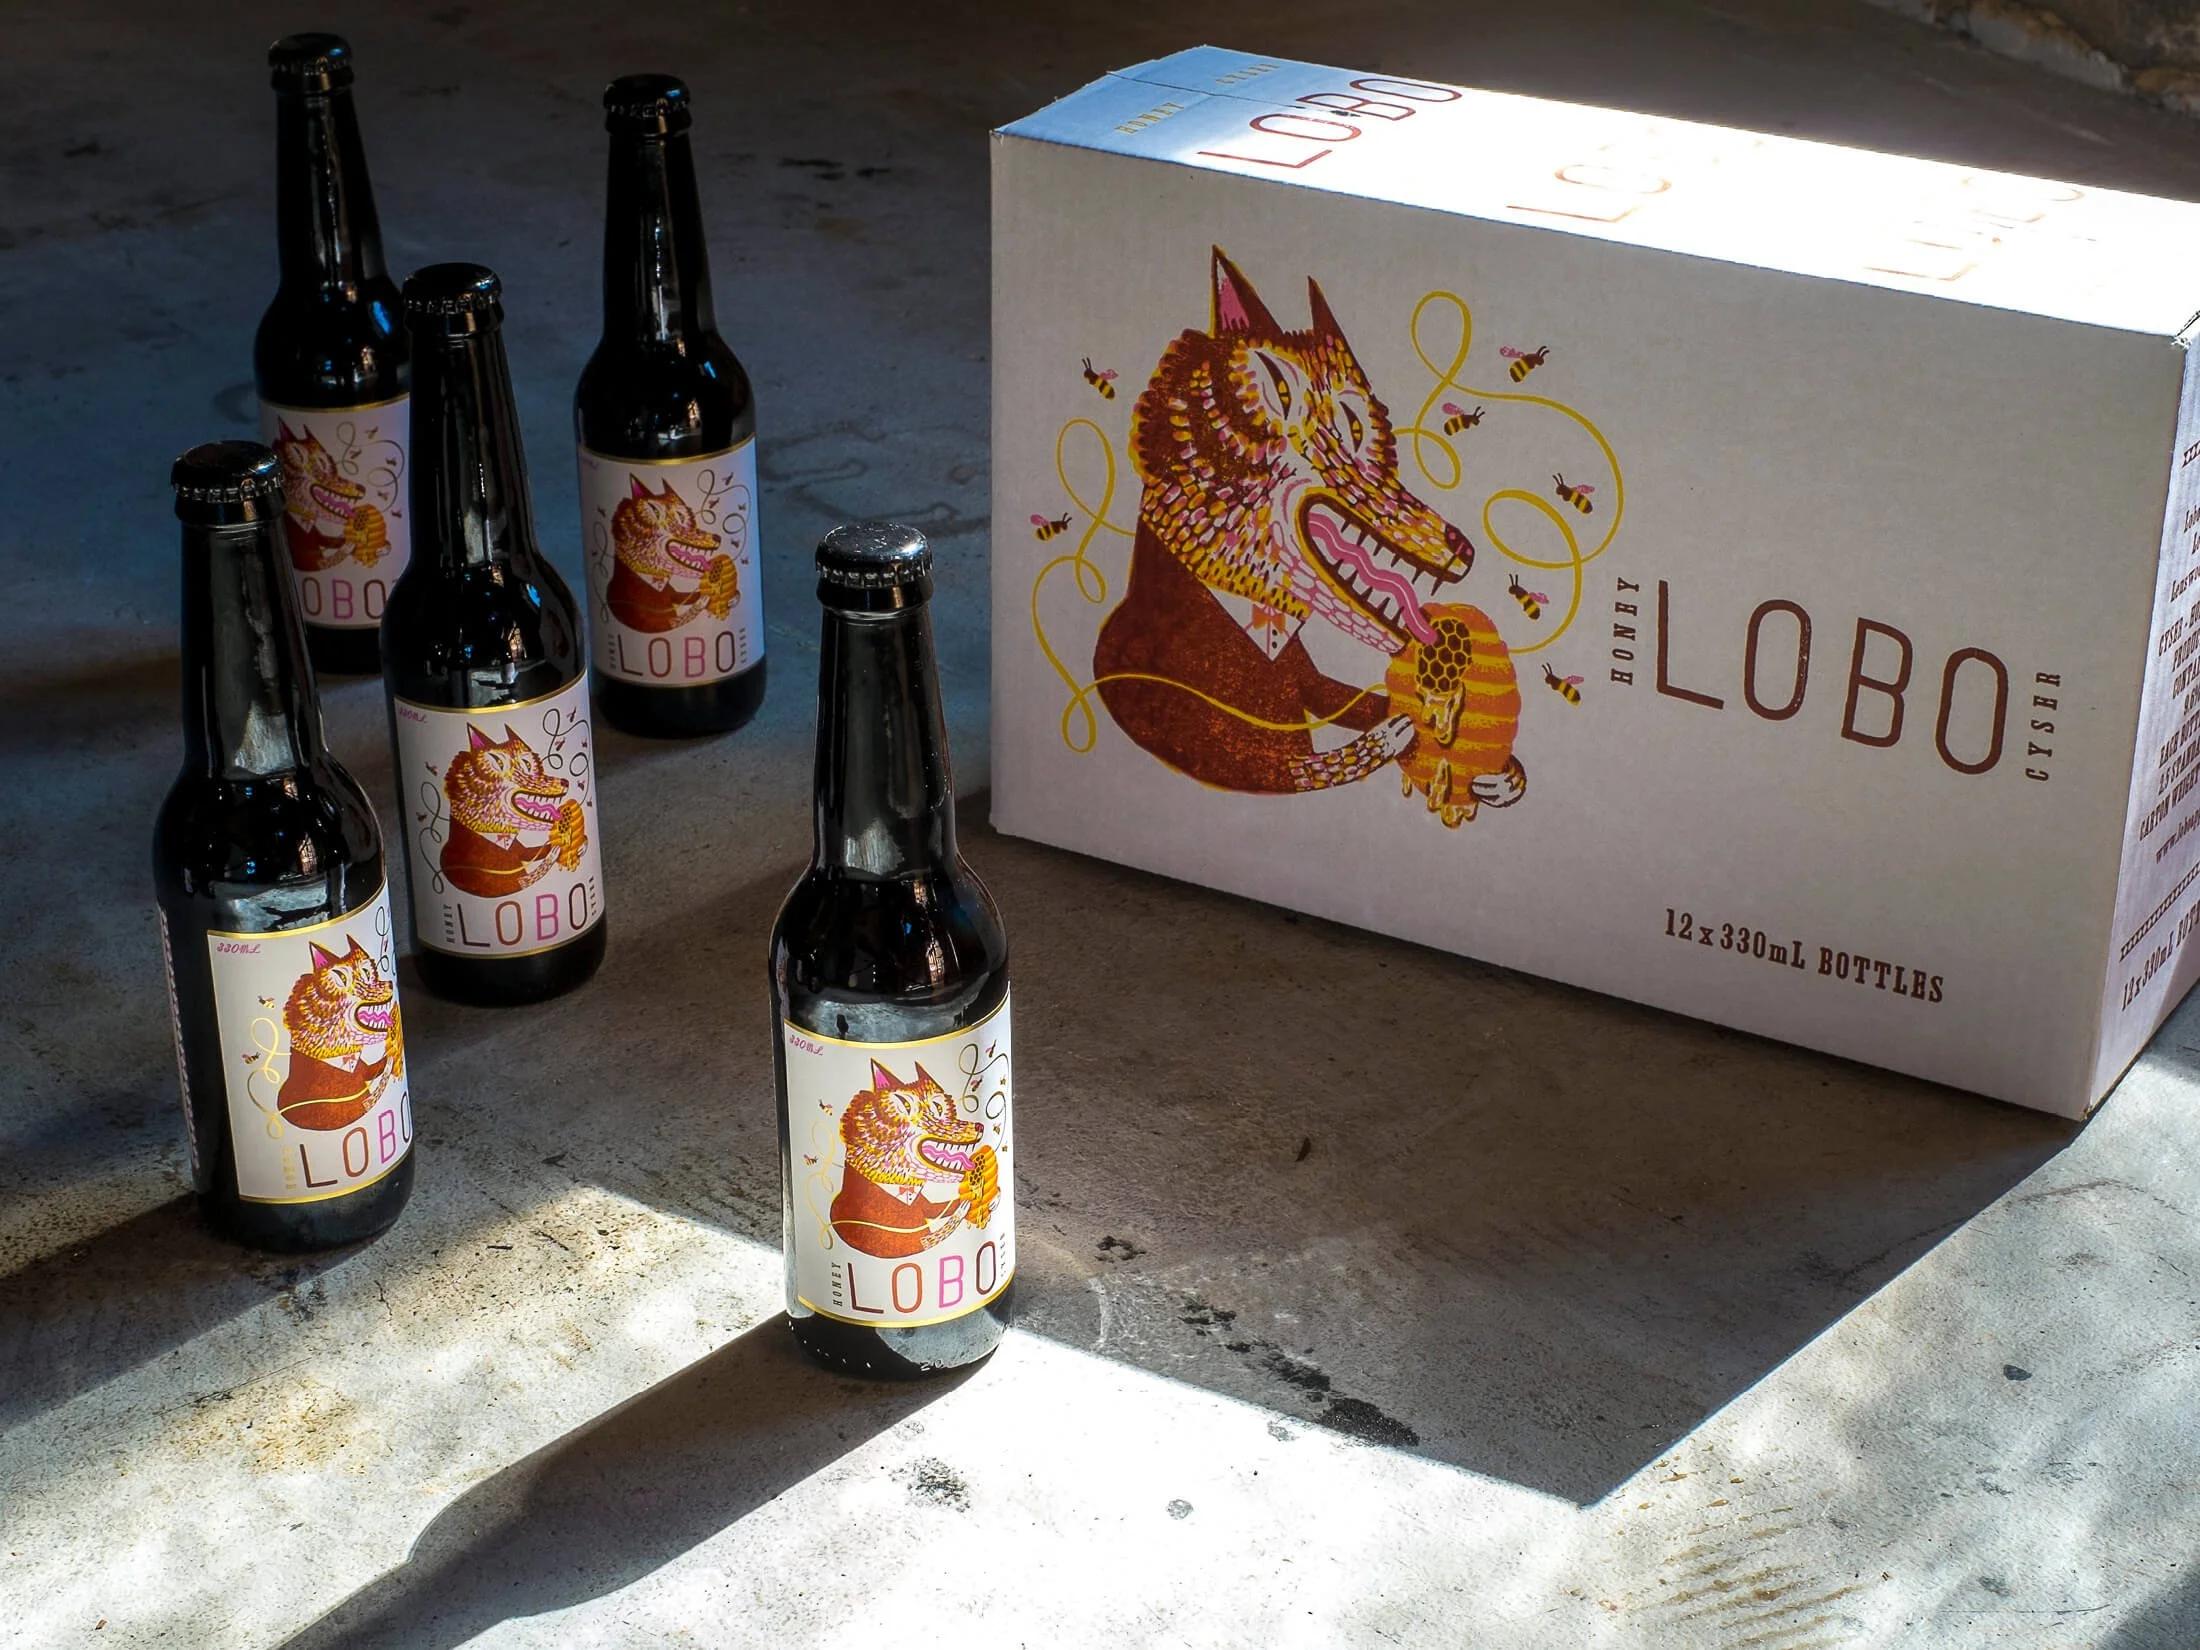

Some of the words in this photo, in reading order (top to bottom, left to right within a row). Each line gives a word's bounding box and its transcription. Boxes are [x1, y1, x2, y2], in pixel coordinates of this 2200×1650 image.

[1114, 102, 1185, 135] HONEY
[1198, 78, 1463, 168] LOBO
[302, 577, 387, 619] OBO
[1609, 576, 1641, 686] HONEY
[617, 630, 736, 678] LOBO
[1655, 579, 2009, 775] LOBO
[2025, 670, 2062, 782] CYSER
[457, 882, 588, 947] LOBO
[1664, 907, 1693, 941] 12
[1698, 924, 1715, 948] x
[1720, 922, 1806, 970] 330mL
[1817, 946, 1944, 1004] BOTTLES
[300, 1091, 412, 1188] LOBO
[832, 1261, 844, 1307] HONEY
[847, 1241, 997, 1314] LOBO
